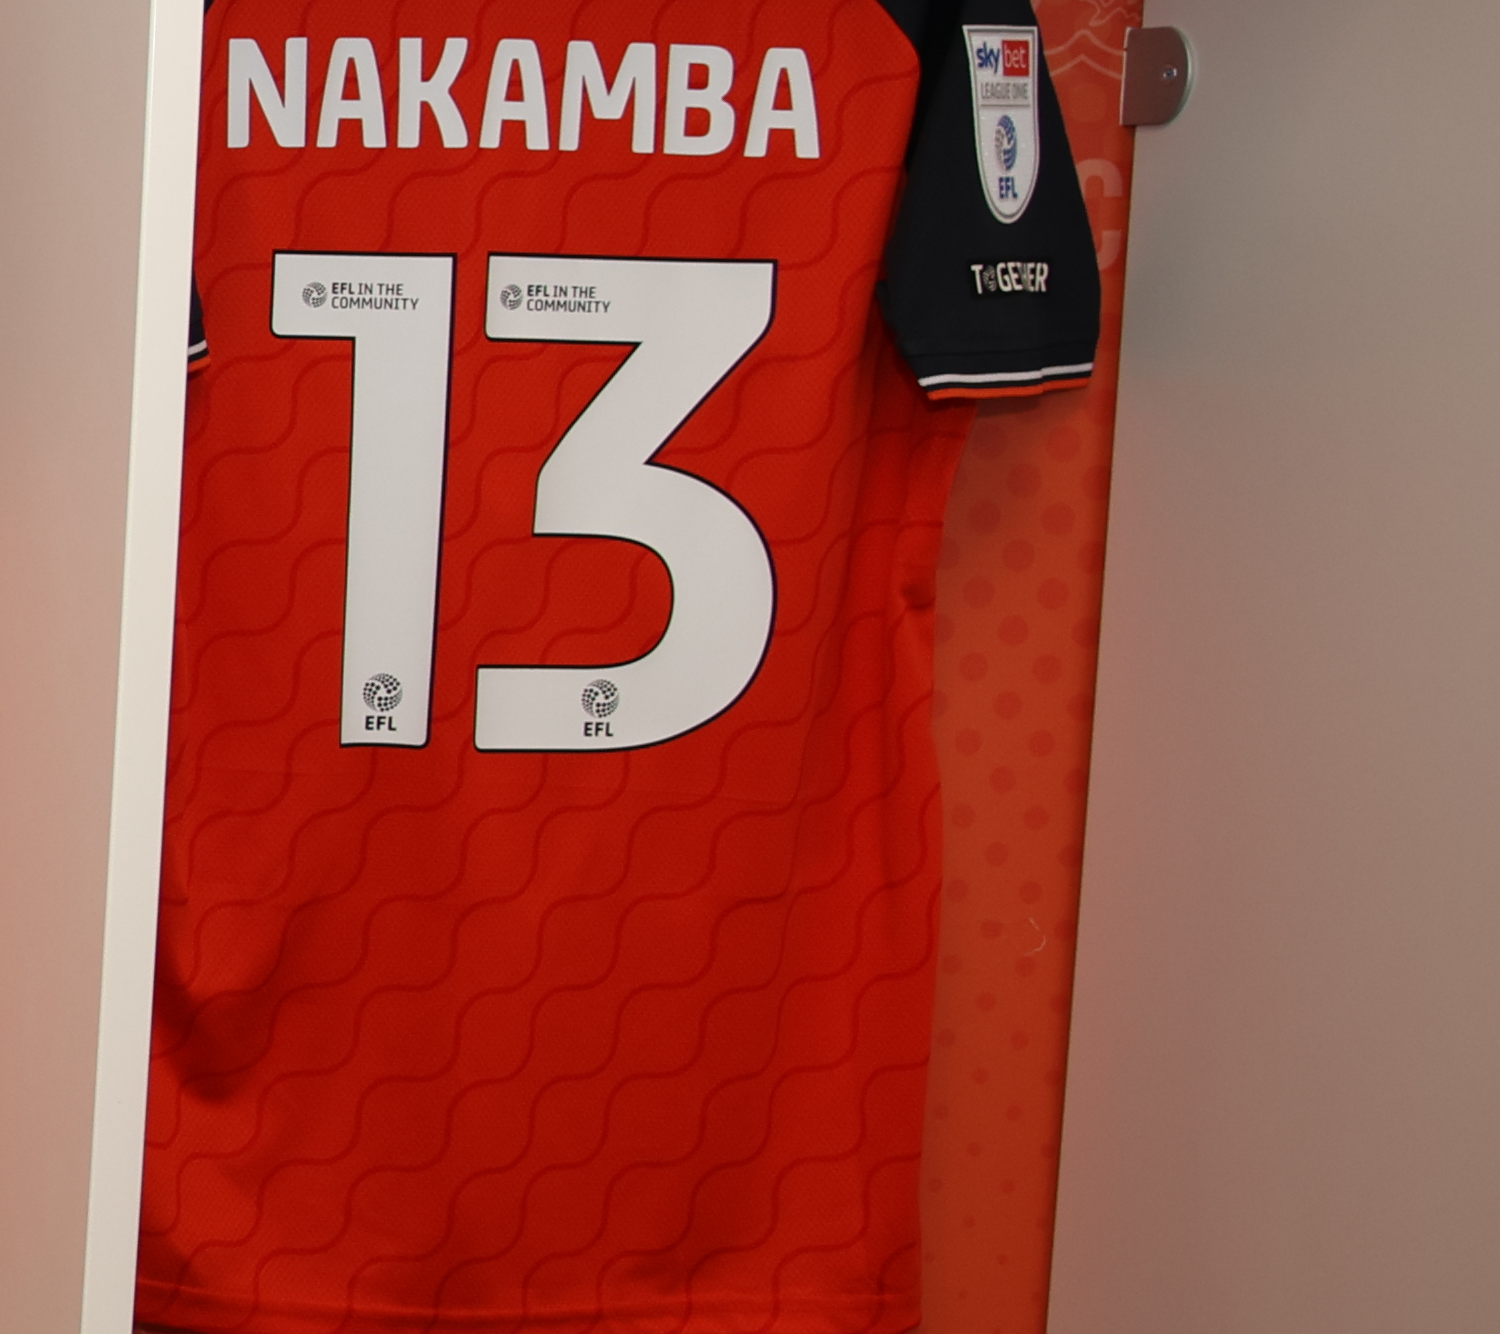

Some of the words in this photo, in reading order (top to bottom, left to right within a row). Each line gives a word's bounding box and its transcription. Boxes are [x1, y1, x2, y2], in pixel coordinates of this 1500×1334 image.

[976, 41, 1001, 75] sky
[1003, 43, 1027, 69] bet
[226, 36, 821, 159] NAKAMBA
[980, 82, 1011, 100] LEAGUE
[1012, 82, 1030, 100] ONE
[998, 176, 1018, 200] EFL
[331, 282, 355, 295] EFL
[357, 283, 375, 295] IN
[378, 283, 404, 296] THE
[526, 284, 550, 298] EFL
[552, 285, 568, 298] IN
[571, 285, 596, 299] THE
[331, 295, 419, 311] COMMUNITY
[526, 298, 611, 314] COMMUNITY
[270, 250, 778, 754] 13
[364, 714, 397, 732] EFL
[583, 721, 614, 738] EFL
